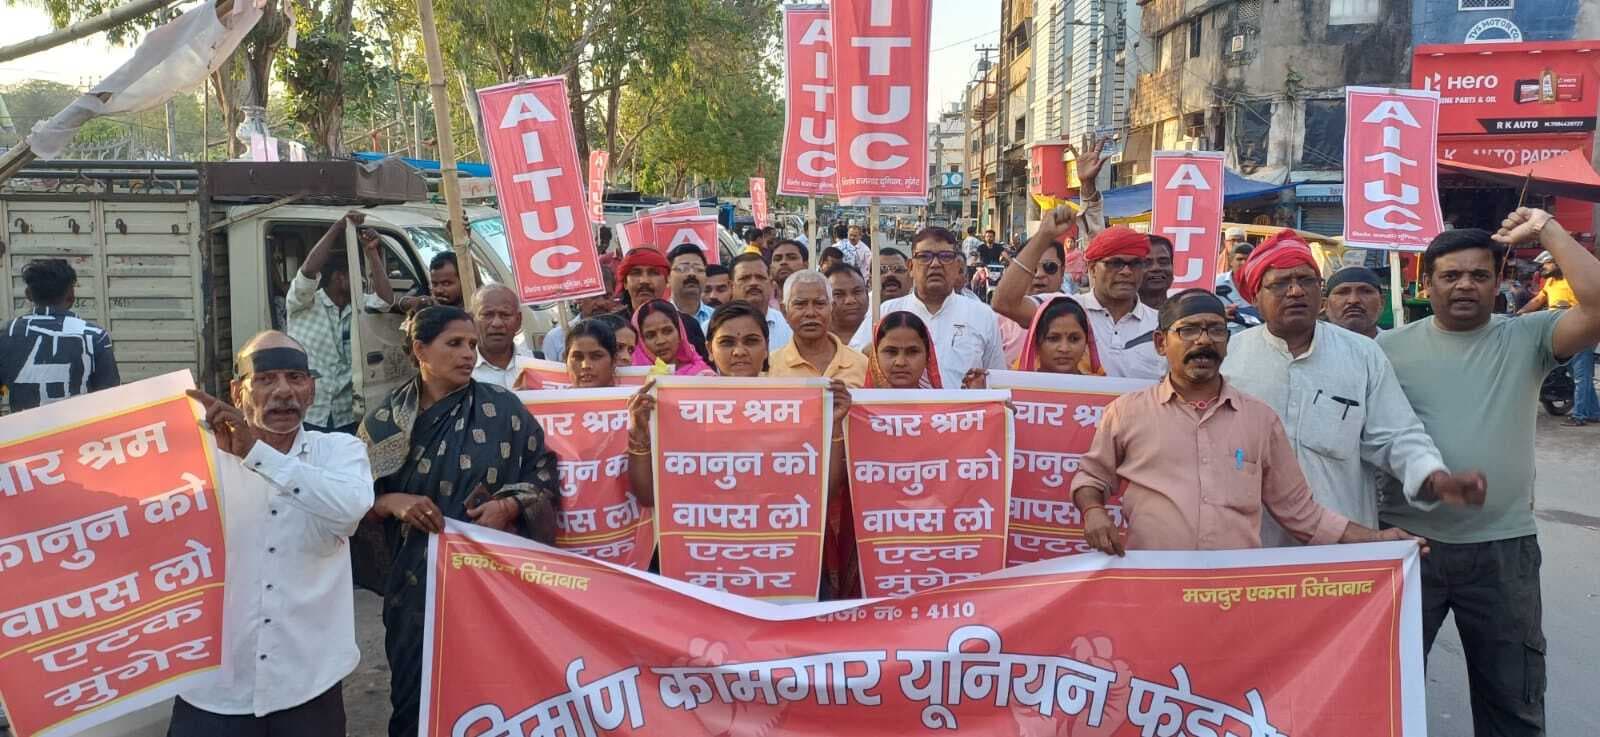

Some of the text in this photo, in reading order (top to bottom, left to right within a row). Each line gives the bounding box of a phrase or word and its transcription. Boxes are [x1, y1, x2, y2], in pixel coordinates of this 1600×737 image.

[797, 19, 837, 177] AITUC
[850, 0, 912, 170] ITUC
[1505, 121, 1512, 129] K
[1513, 121, 1539, 129] AUTO
[1361, 100, 1424, 232] AITUC
[1521, 149, 1569, 165] PAR
[499, 92, 585, 278] AITUC
[1163, 164, 1211, 294] AITU
[582, 408, 630, 434] श्रम
[678, 399, 803, 425] चार श्रम
[868, 409, 987, 437] चार श्रम
[1012, 400, 1068, 426] चार
[76, 421, 169, 470] श्रम
[663, 442, 818, 490] कानुन को
[853, 448, 1002, 496] कानुन को
[139, 472, 209, 525] को
[603, 492, 641, 530] लो
[672, 494, 811, 529] वापस लो
[862, 498, 994, 533] वापस लो
[685, 543, 796, 561] एटक
[873, 544, 981, 564] एटक
[0, 538, 214, 639] वापस लो
[685, 566, 794, 593] मुंगेर
[1245, 584, 1297, 603] एकता
[1302, 577, 1375, 598] जिंदाबाद
[926, 601, 975, 619] 4110
[27, 600, 204, 673] एटक
[44, 635, 213, 712] मुंगेर
[650, 649, 887, 711] कामगार
[896, 624, 1118, 731] यूनियन
